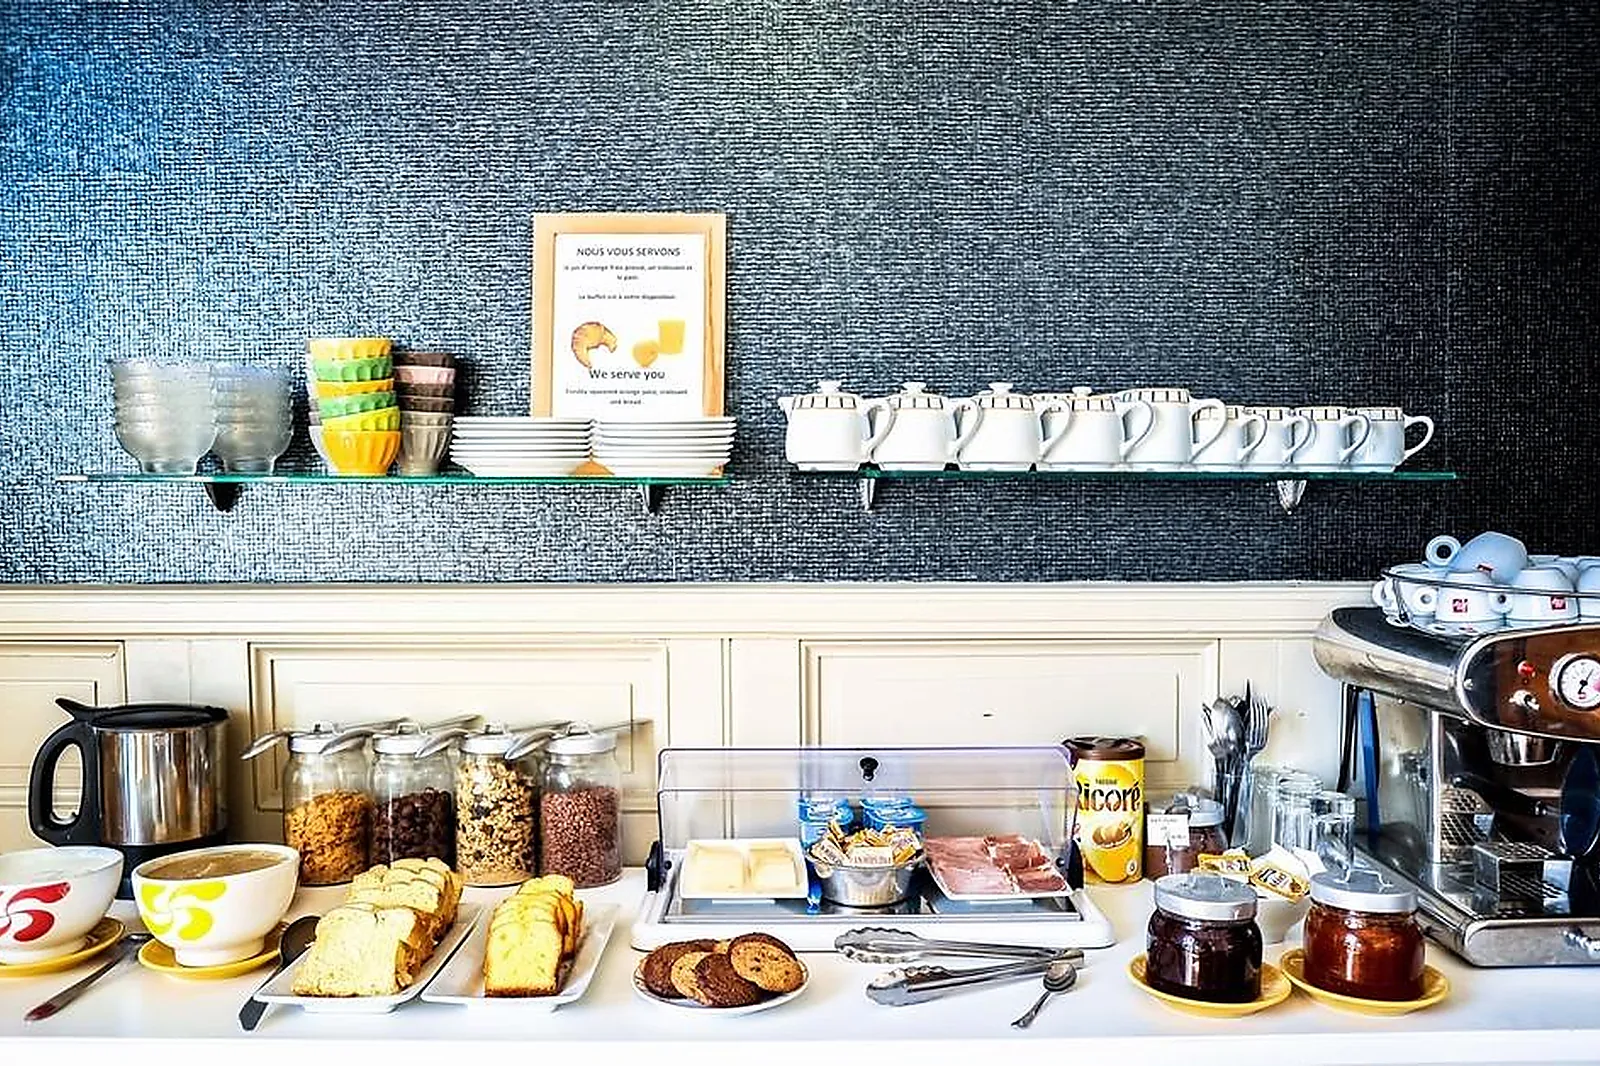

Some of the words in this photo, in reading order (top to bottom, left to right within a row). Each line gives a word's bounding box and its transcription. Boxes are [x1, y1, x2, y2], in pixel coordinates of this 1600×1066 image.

[576, 247, 605, 257] NOUS
[606, 247, 635, 257] VOUS
[635, 247, 681, 257] SERVONS
[588, 369, 608, 379] We
[610, 371, 641, 379] serve
[643, 371, 666, 381] you
